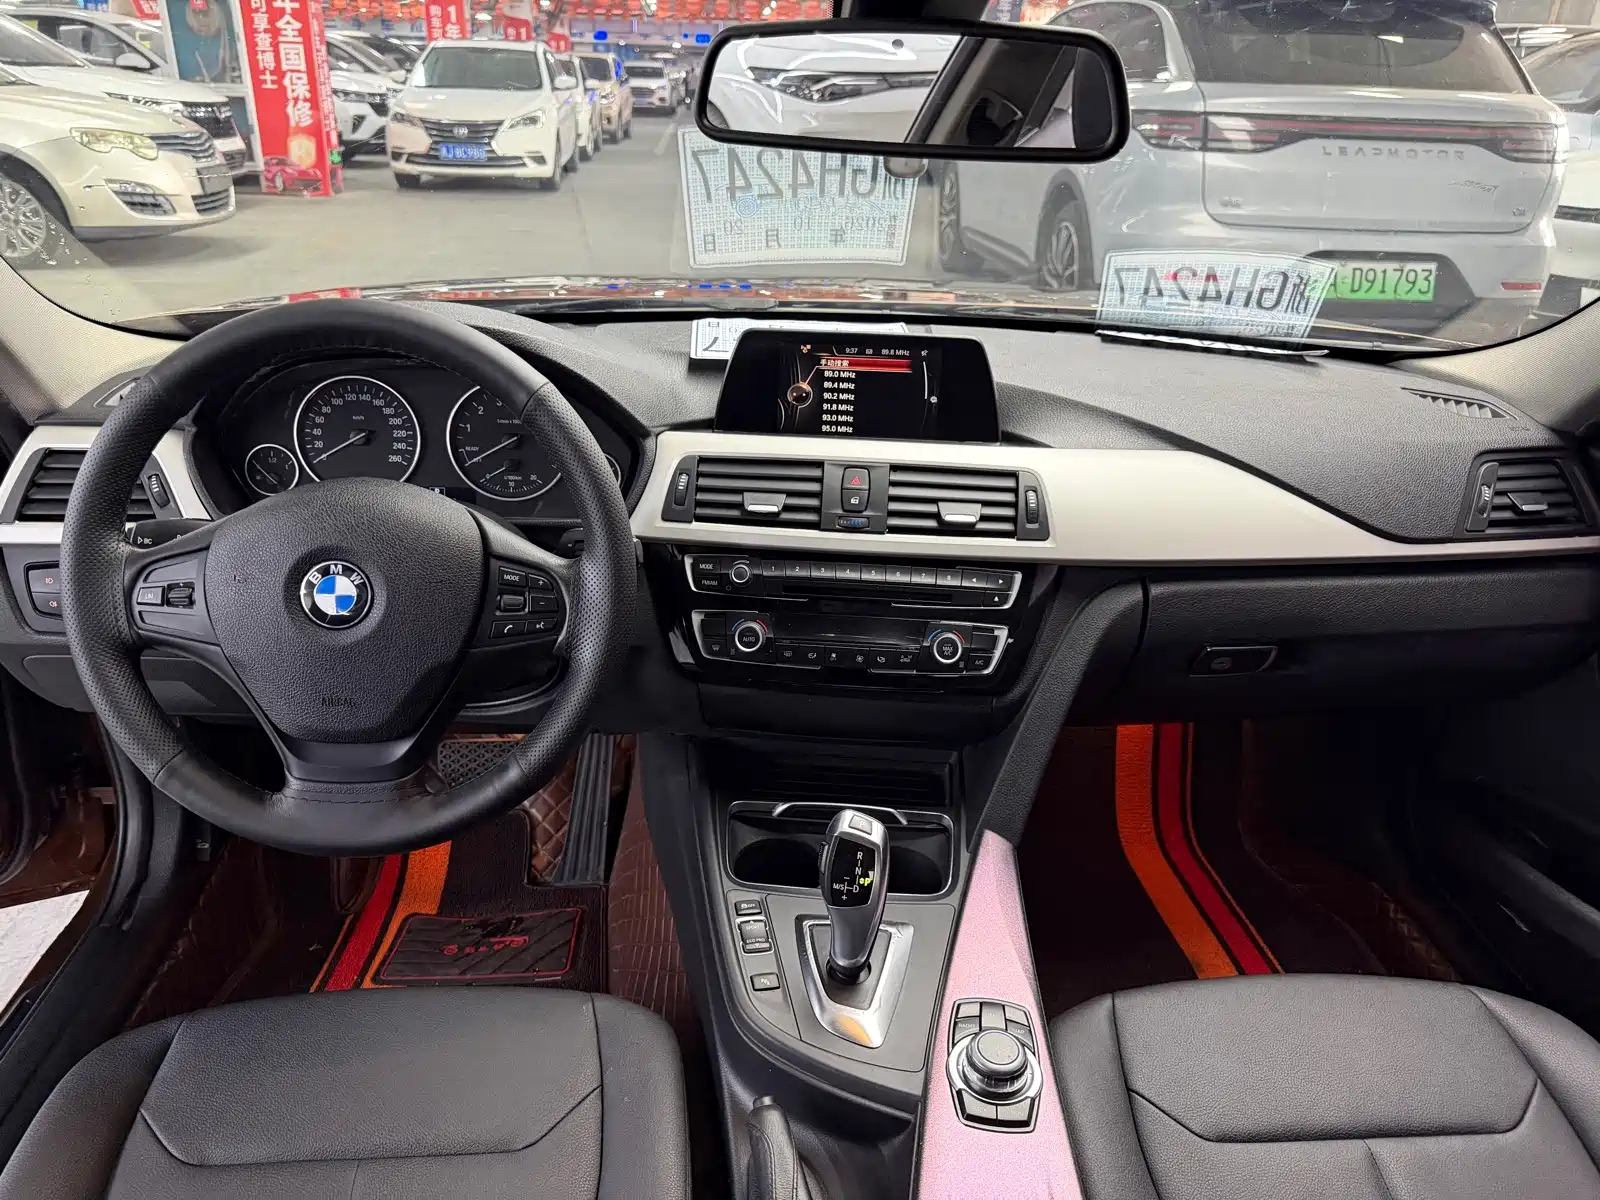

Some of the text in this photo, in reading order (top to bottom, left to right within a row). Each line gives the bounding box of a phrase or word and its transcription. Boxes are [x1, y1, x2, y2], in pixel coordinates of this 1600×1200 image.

[478, 406, 484, 414] 2
[466, 424, 471, 432] 1
[308, 564, 364, 585] BMW
[504, 574, 520, 582] MODE
[857, 851, 863, 860] R
[855, 866, 862, 875] N
[853, 885, 859, 893] D
